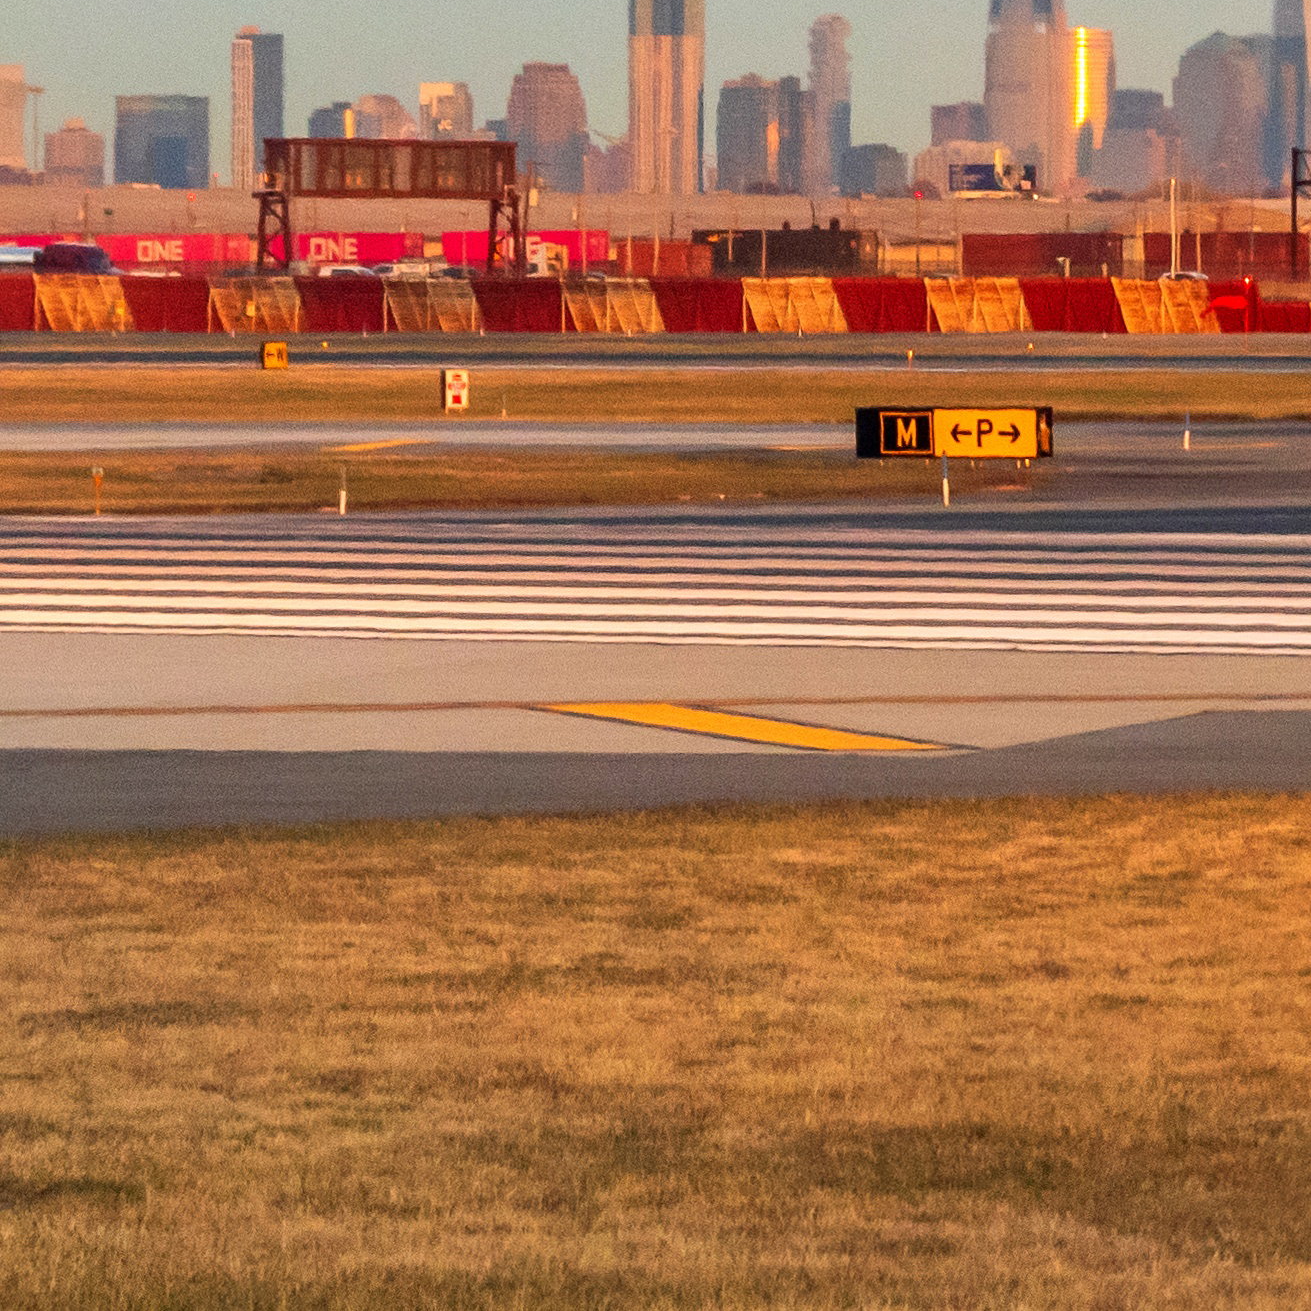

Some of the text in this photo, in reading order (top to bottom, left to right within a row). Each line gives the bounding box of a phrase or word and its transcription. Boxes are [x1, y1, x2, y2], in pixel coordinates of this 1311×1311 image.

[137, 240, 183, 262] ONE
[309, 236, 358, 261] ONE
[896, 417, 994, 448] M P
